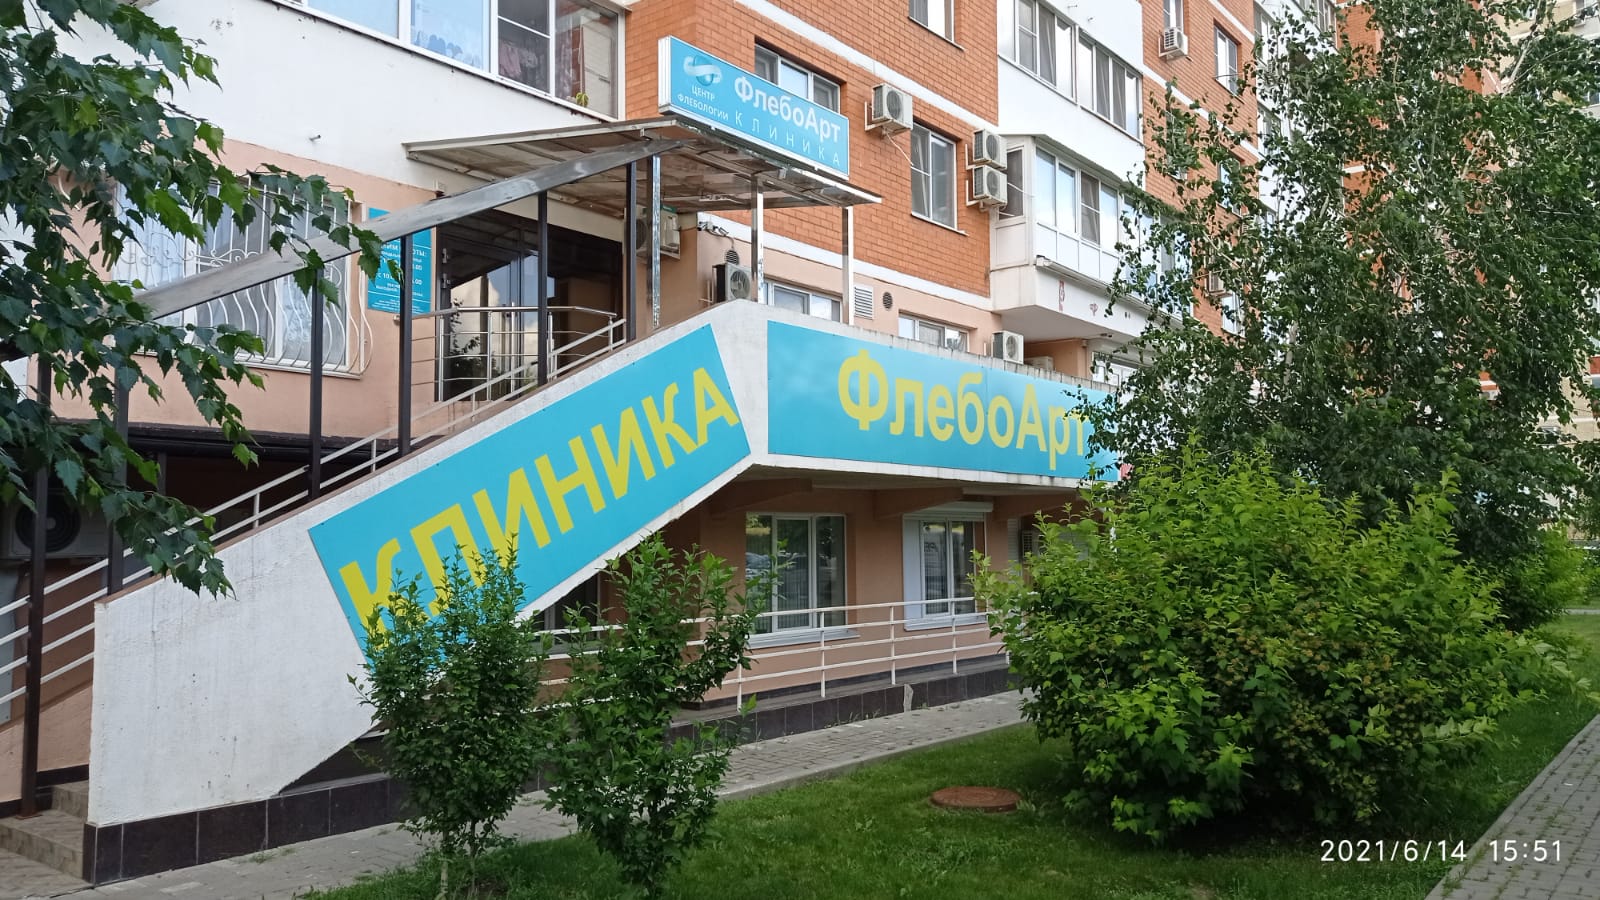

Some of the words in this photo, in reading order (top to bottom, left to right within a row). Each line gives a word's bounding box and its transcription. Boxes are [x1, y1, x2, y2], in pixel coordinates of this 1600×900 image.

[677, 93, 729, 121] ФЛЕБОЛОГИИ
[691, 84, 716, 101] ЦЕНТР
[734, 75, 841, 143] ФлебоАрт
[837, 349, 1090, 471] ФлебоАрт
[338, 367, 740, 650] КЛИНИКА
